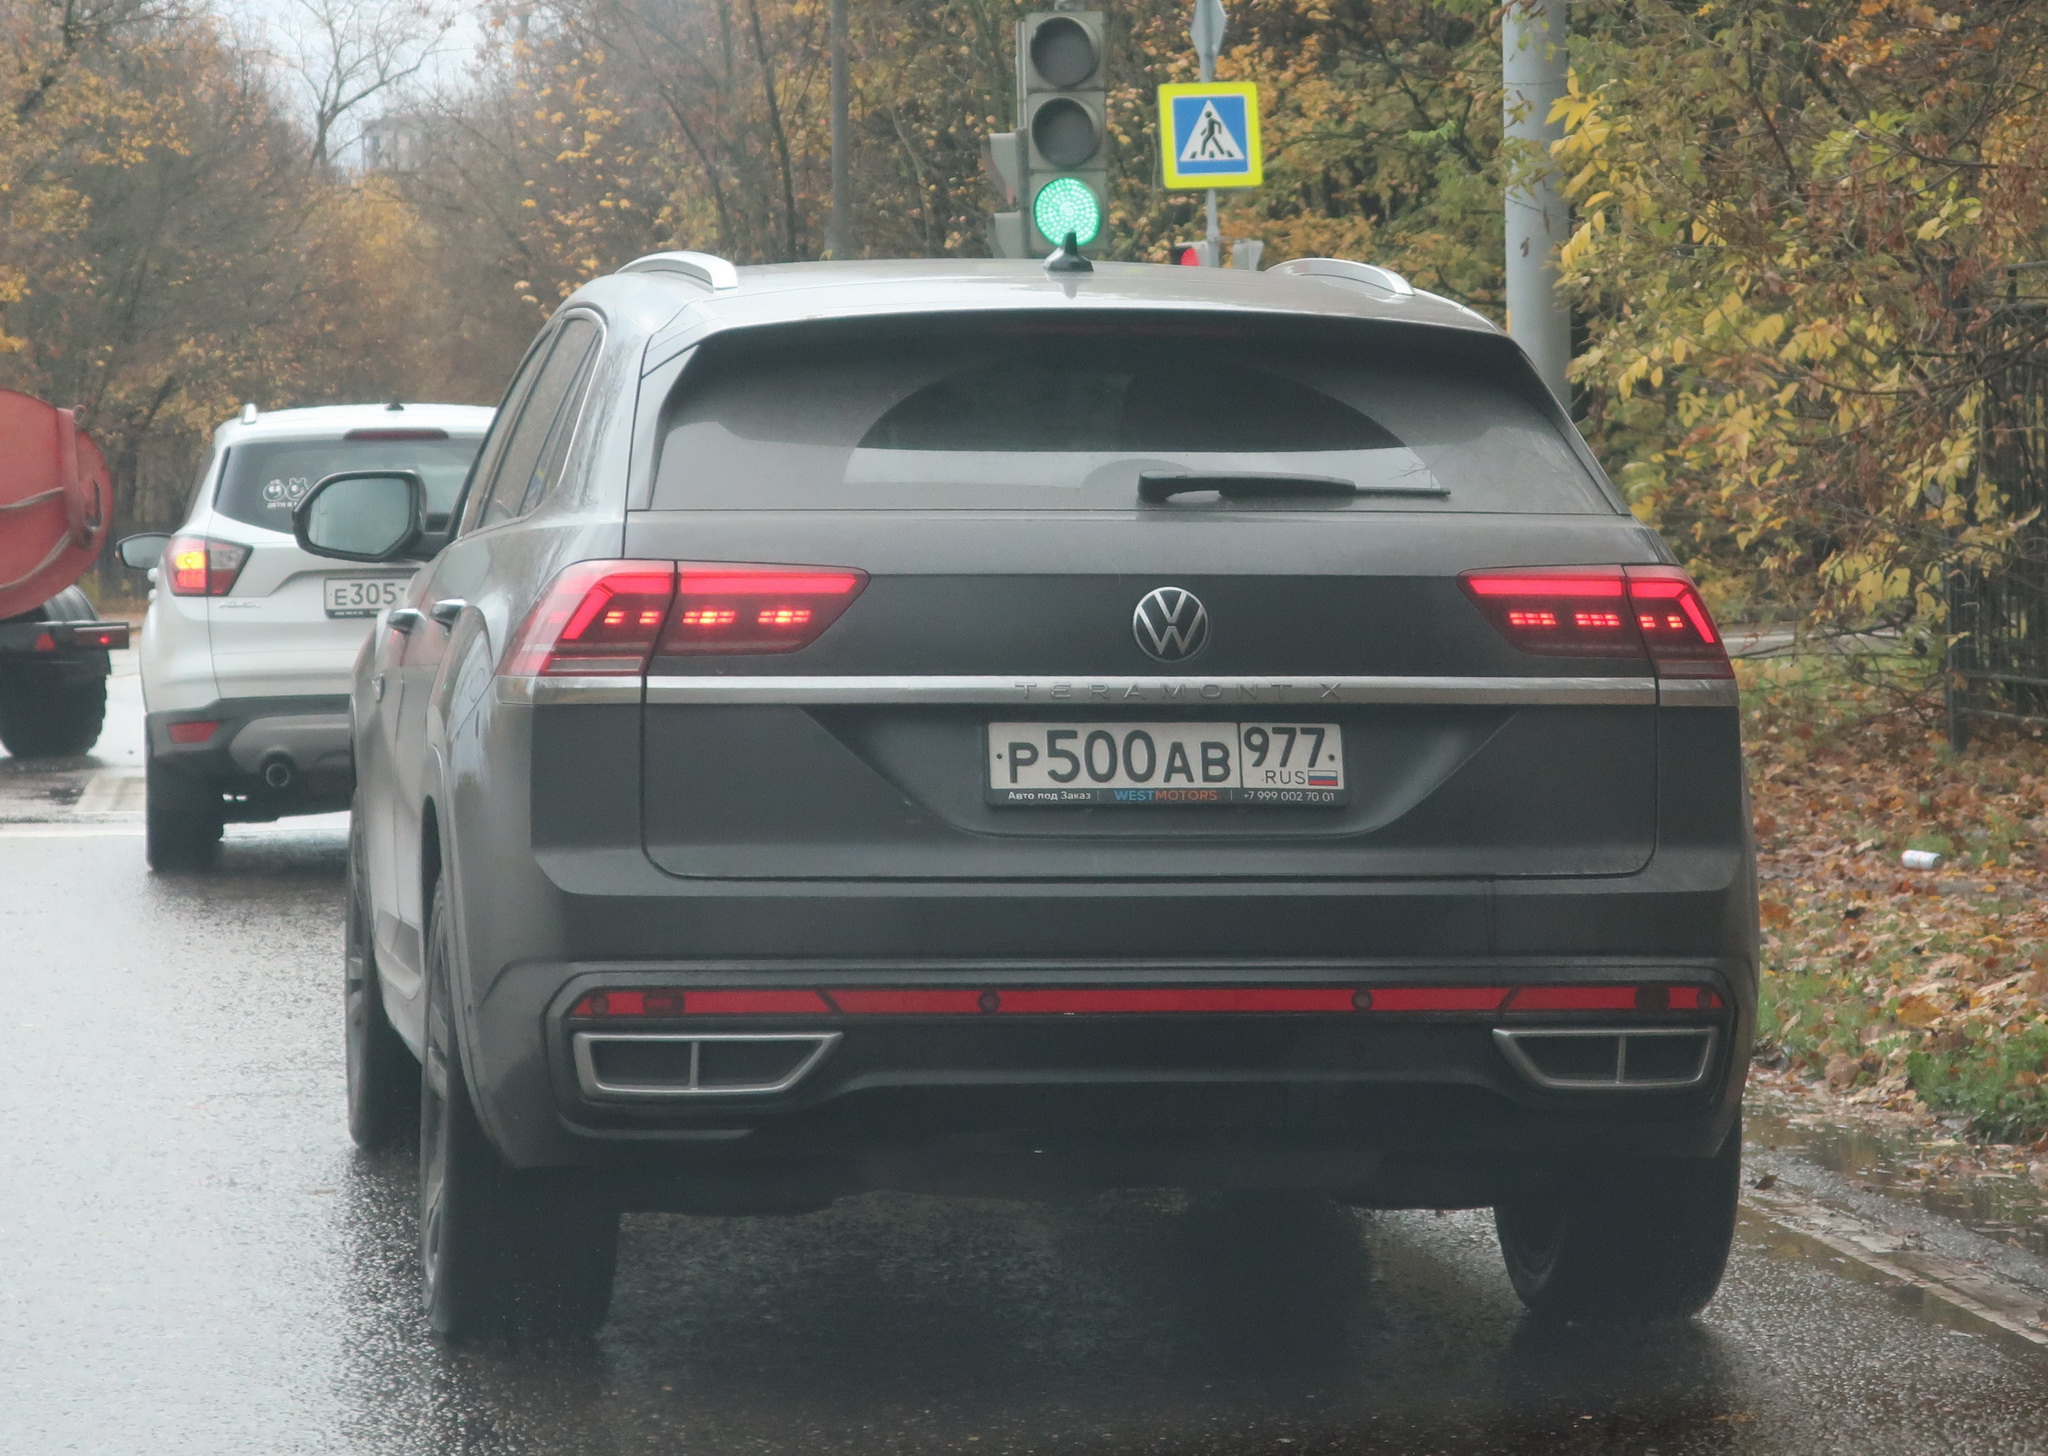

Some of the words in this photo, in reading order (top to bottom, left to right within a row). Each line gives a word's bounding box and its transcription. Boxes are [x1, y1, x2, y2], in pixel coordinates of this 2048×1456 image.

[334, 582, 405, 606] Е305
[1015, 681, 1294, 700] TERAMONT
[1319, 682, 1343, 699] X
[1243, 726, 1326, 768] 977
[1265, 770, 1306, 785] RUS
[1008, 791, 1035, 801] Авто
[1037, 792, 1058, 801] под
[1060, 791, 1091, 800] Заказ
[1114, 790, 1218, 801] WESTMOTORS
[1243, 791, 1255, 800] +7
[1257, 791, 1278, 800] 999
[1280, 791, 1303, 801] 002
[1306, 792, 1319, 801] 70
[1322, 792, 1335, 801] 01
